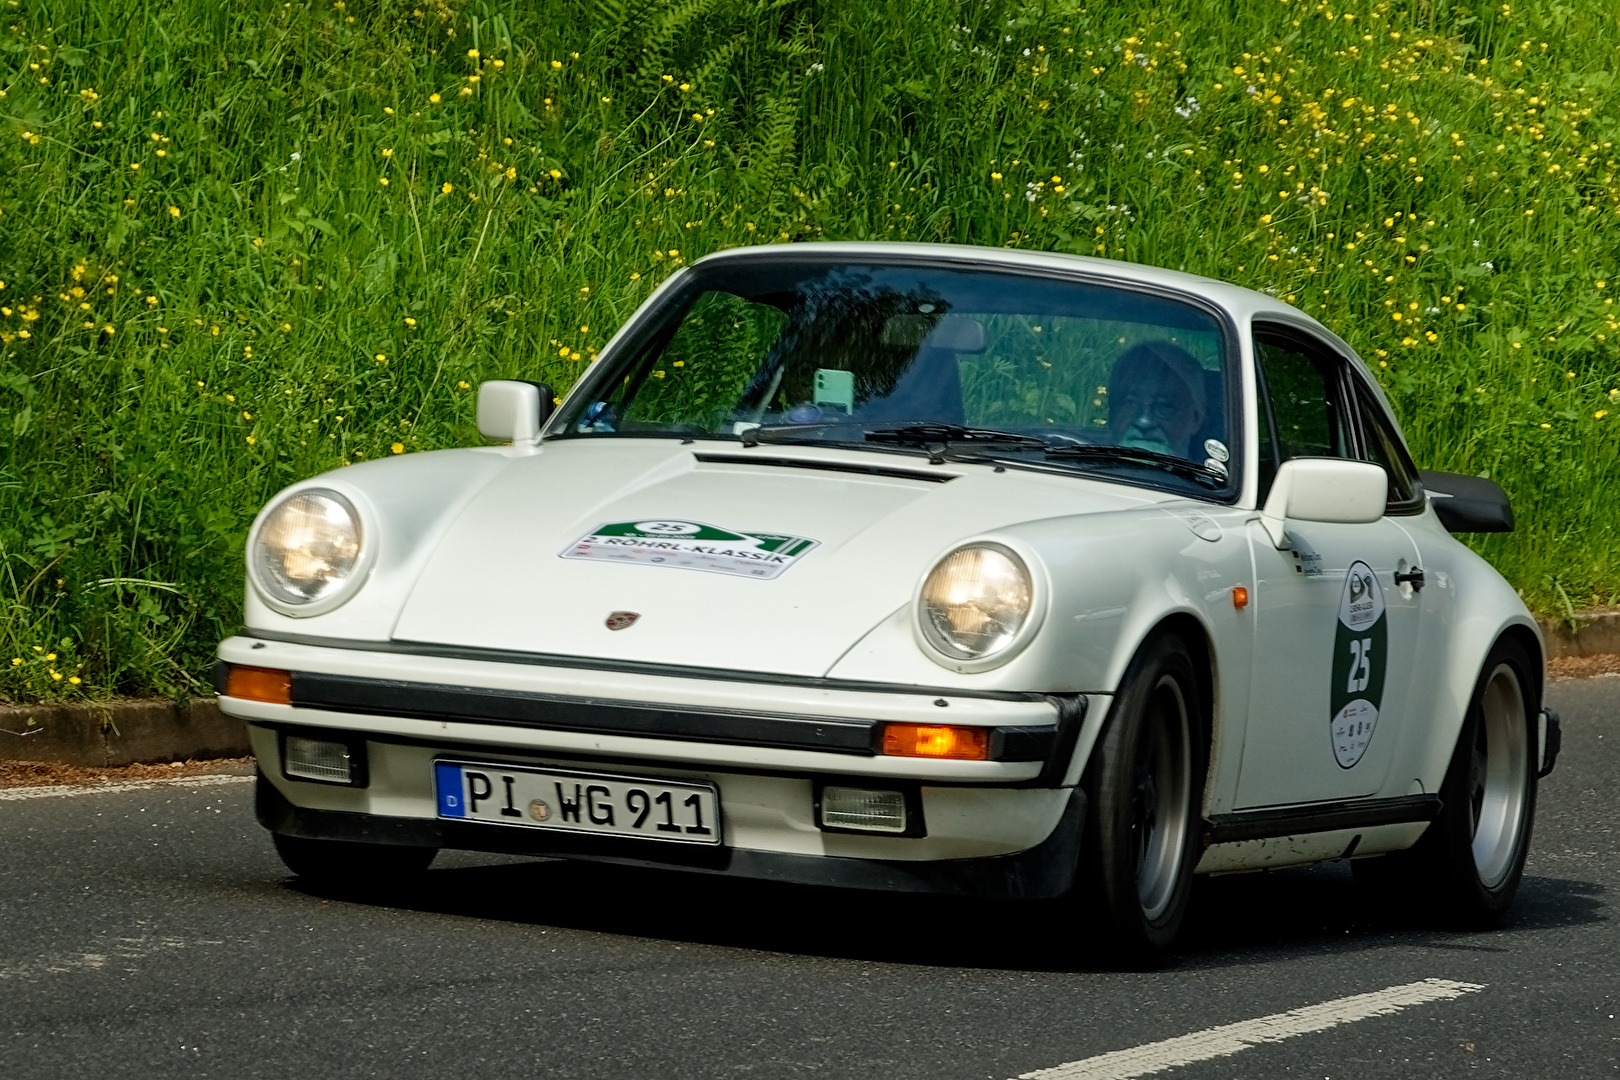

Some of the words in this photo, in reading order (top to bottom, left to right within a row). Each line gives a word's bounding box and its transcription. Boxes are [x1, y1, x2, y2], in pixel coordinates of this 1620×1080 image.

[651, 523, 685, 532] 25
[606, 537, 785, 563] RÖHRL-KLASSIK
[1346, 638, 1372, 694] 25
[447, 796, 457, 807] D
[465, 771, 521, 818] PI
[554, 781, 615, 827] WG
[626, 789, 711, 836] 911
